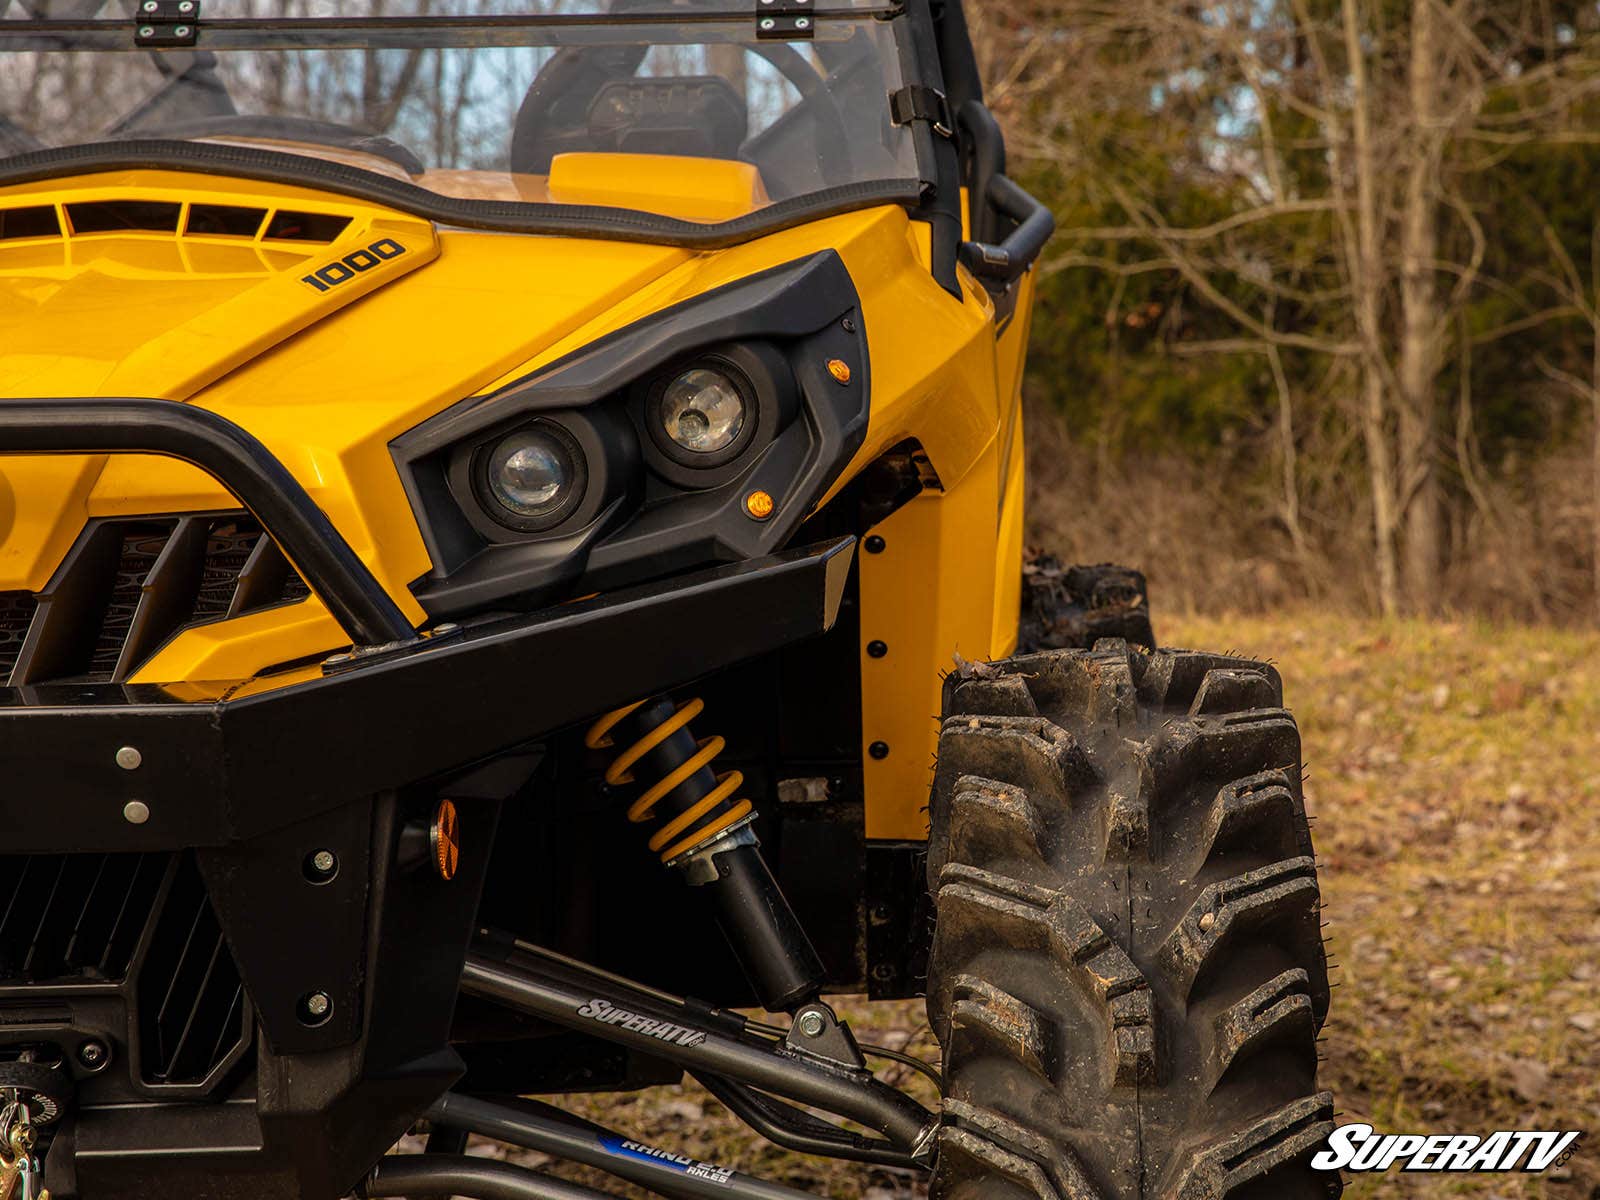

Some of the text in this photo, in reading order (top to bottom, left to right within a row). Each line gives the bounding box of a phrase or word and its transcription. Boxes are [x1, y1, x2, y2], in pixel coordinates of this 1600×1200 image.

[301, 238, 406, 292] 1000
[577, 999, 706, 1047] SUPERATV
[686, 1166, 730, 1184] AXLES
